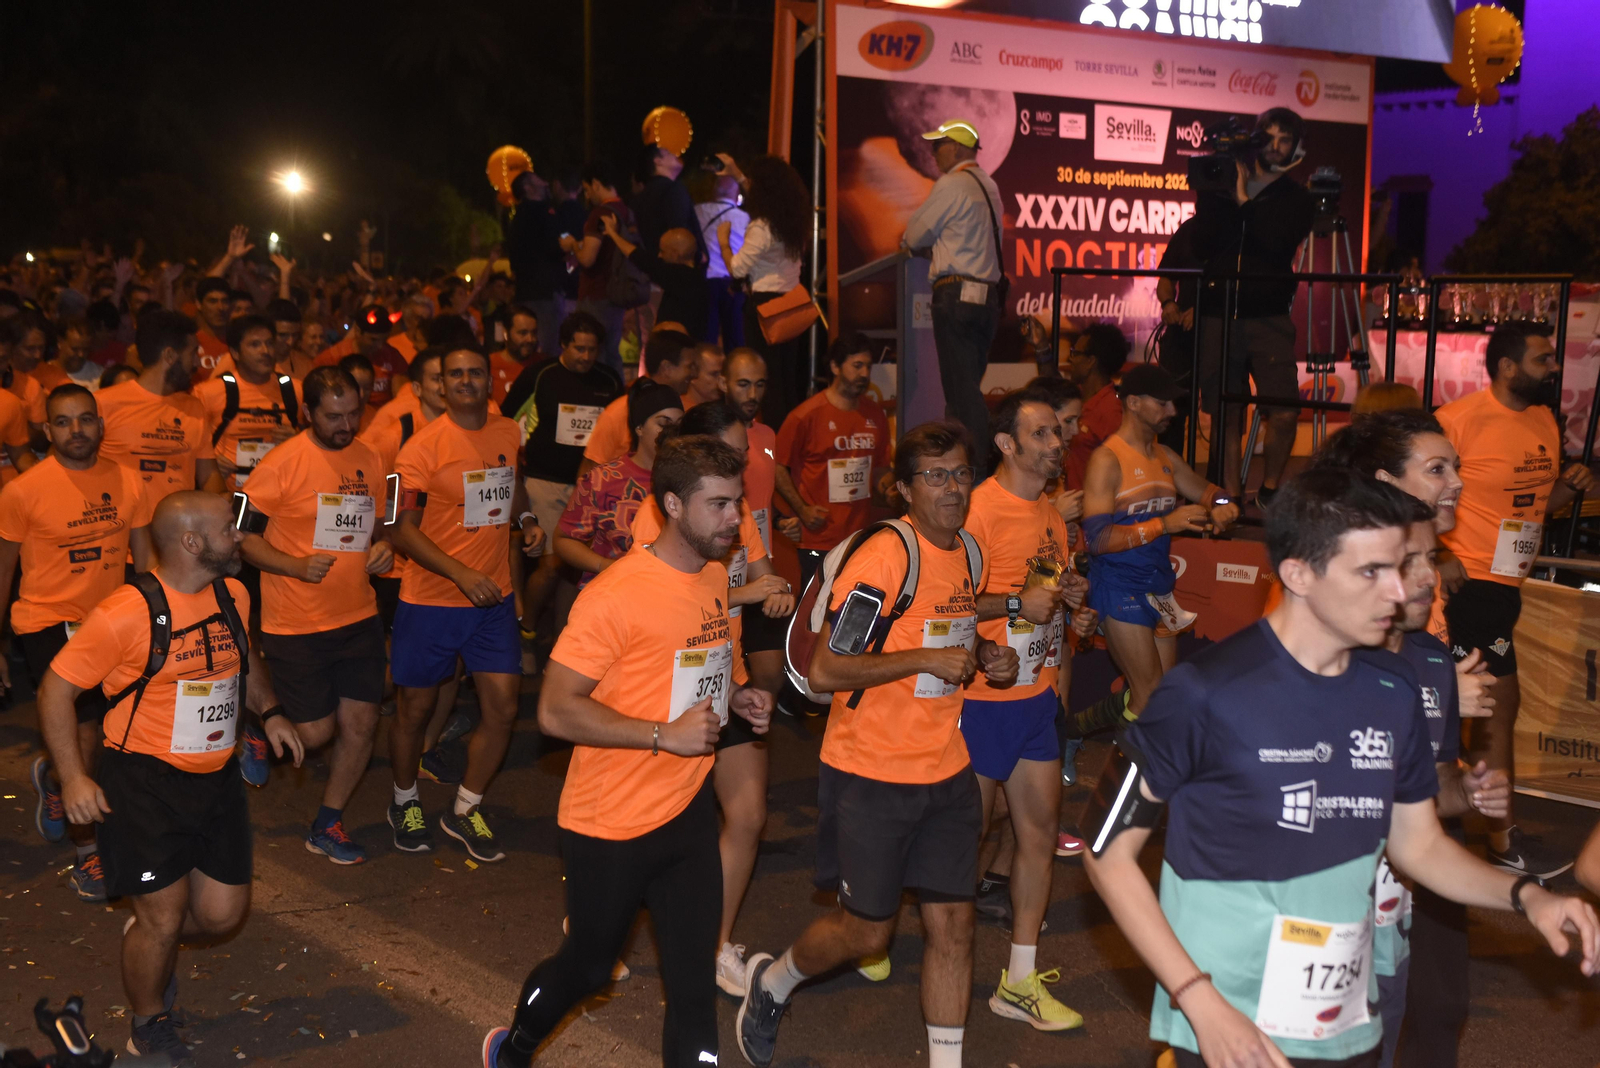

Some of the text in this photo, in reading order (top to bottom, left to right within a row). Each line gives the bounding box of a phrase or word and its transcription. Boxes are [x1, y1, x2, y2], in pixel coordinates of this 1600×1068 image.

[951, 41, 982, 60] ABC
[998, 48, 1063, 73] Cruzcampo
[1075, 60, 1139, 77] TORRE SEVILLA
[1057, 166, 1190, 191] 30 de septiembre 202
[1015, 193, 1107, 232] XXXIV
[1017, 293, 1044, 316] del
[571, 418, 593, 430] 9222
[843, 471, 864, 484] 8322
[478, 485, 511, 503] 14106
[82, 506, 117, 517] NOCTURNA
[67, 517, 98, 528] SEVILLA
[335, 513, 363, 529] 8441
[935, 604, 964, 614] SEVILLA
[701, 619, 729, 632] NOCTURNA
[687, 632, 718, 648] SEVILLA
[175, 644, 216, 662] SEVILA
[696, 672, 724, 698] 3753
[197, 701, 235, 723] 12299
[1348, 726, 1388, 759] 365
[1350, 757, 1393, 770] TRAINING
[1352, 809, 1384, 819] REYES
[1303, 954, 1363, 991] 17254
